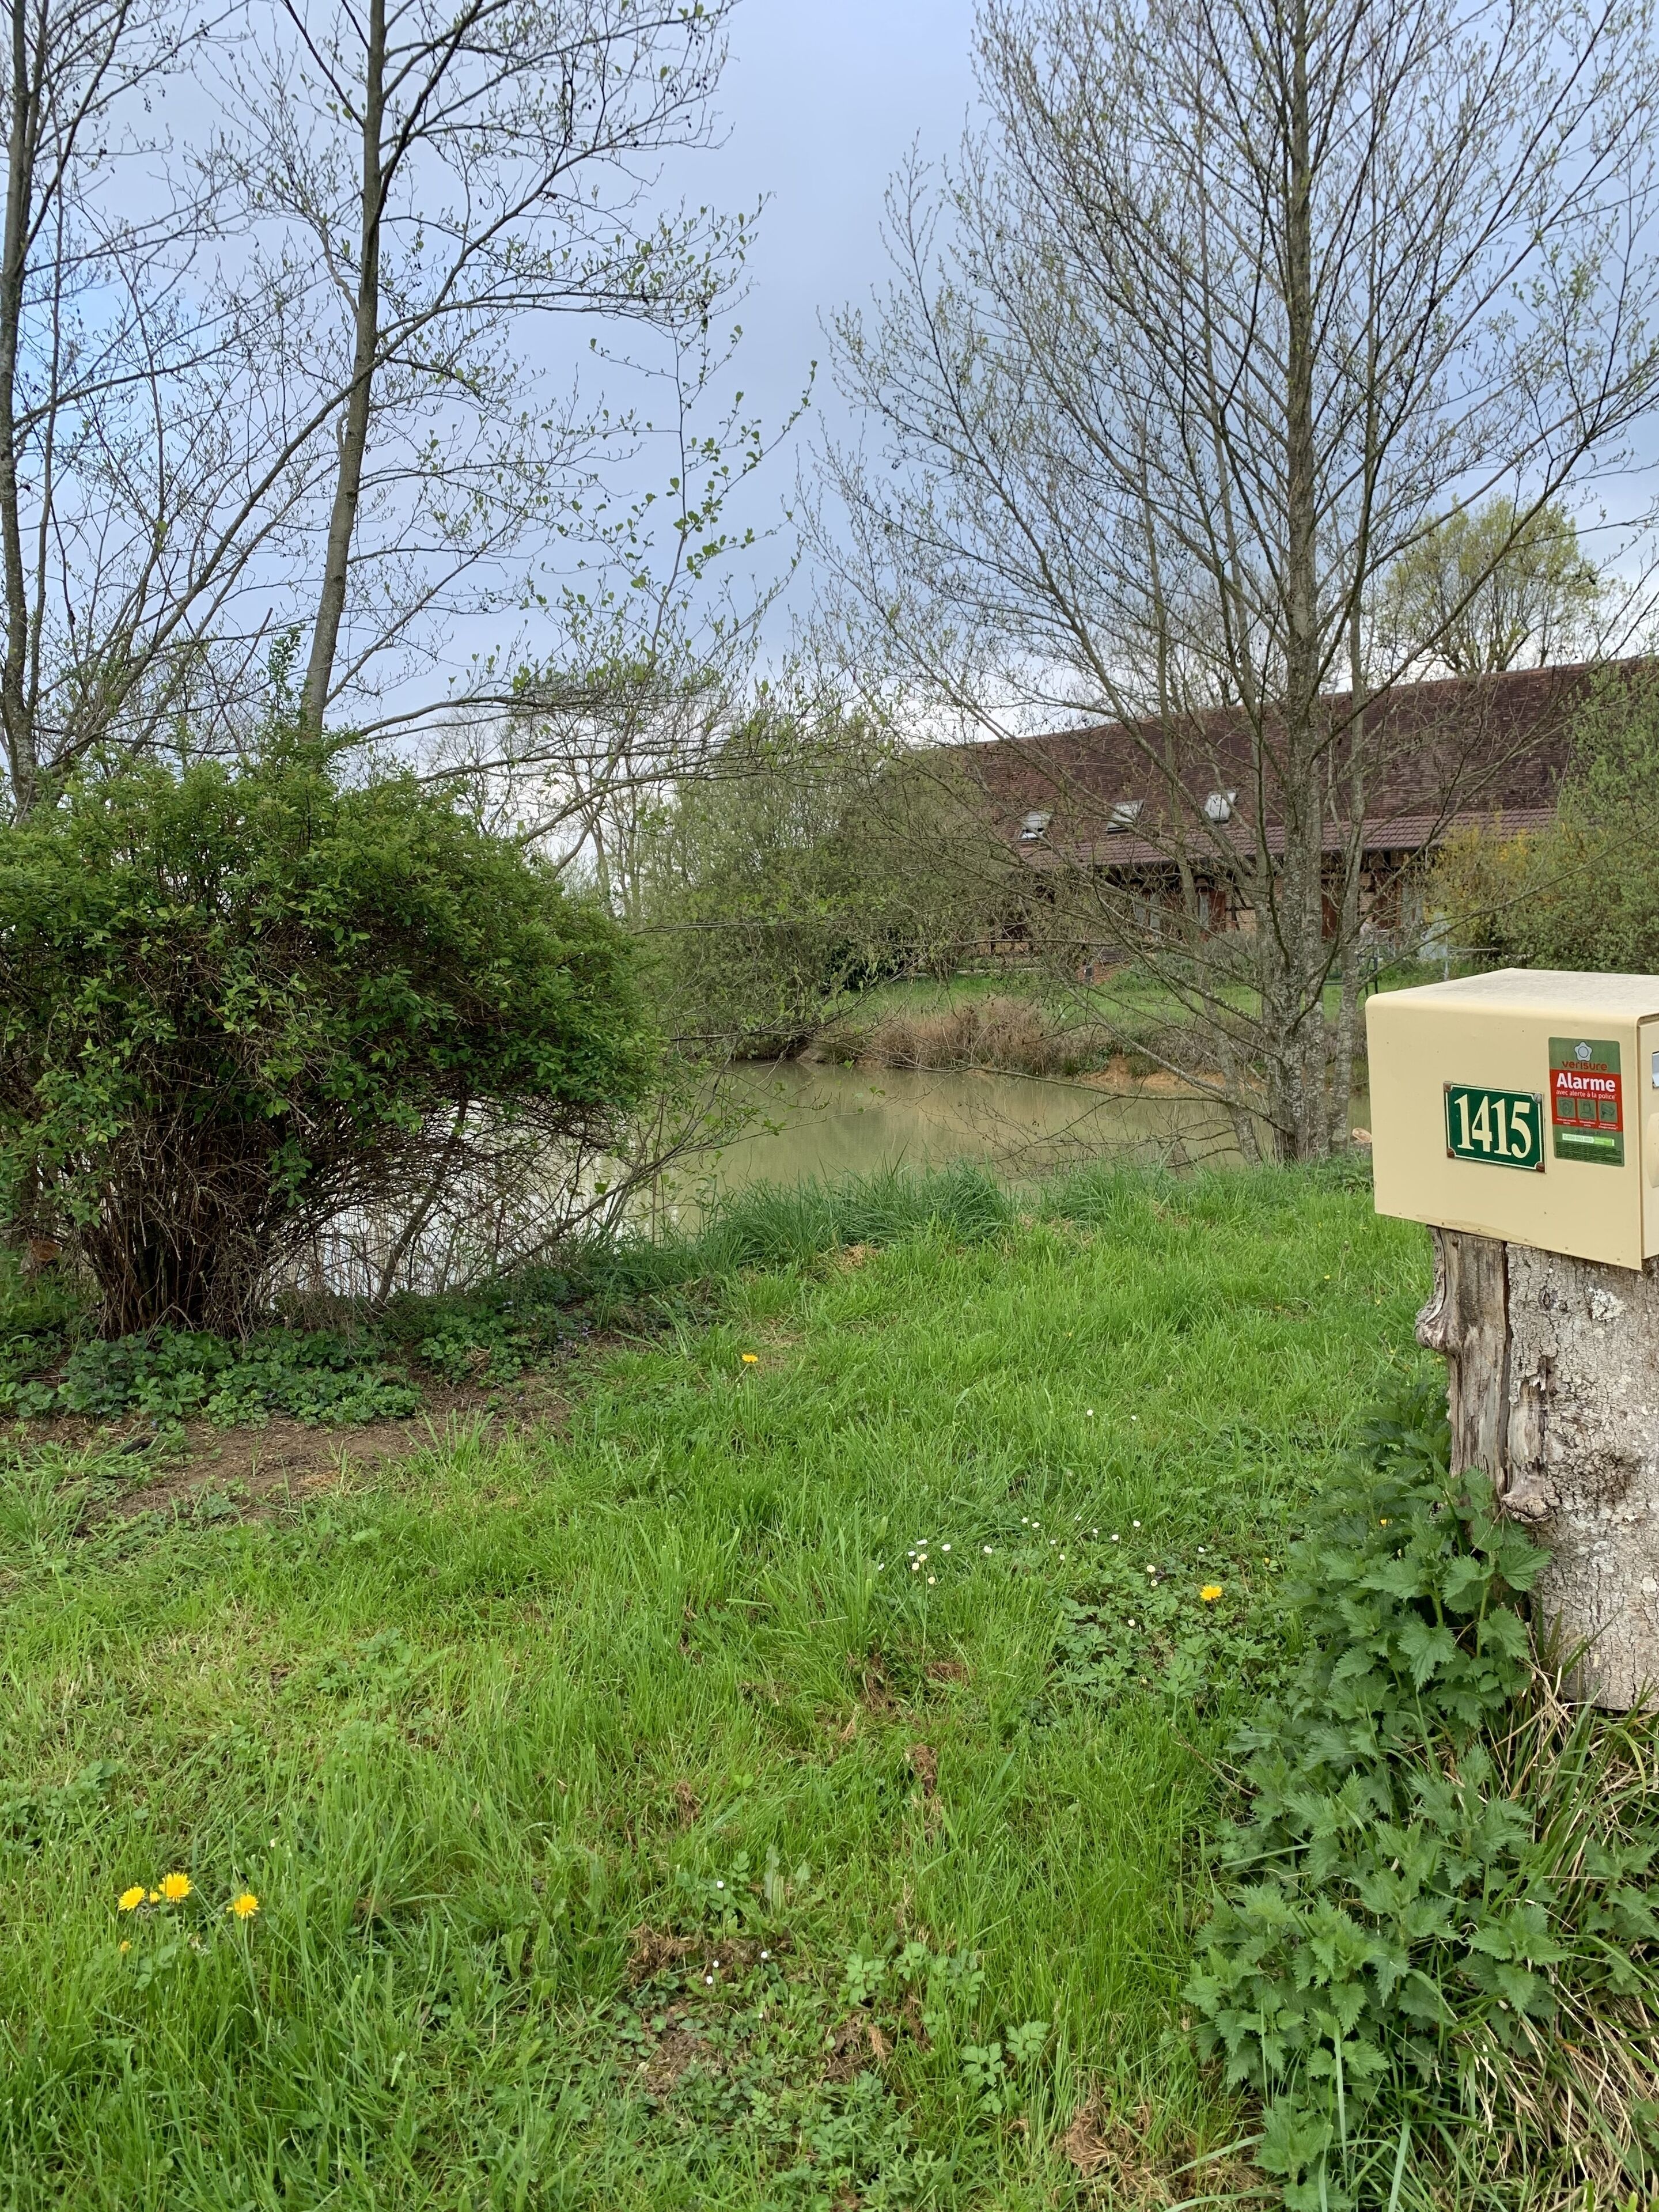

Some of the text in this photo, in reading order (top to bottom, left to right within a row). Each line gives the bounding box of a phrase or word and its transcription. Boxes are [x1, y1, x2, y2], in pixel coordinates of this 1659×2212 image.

[1562, 1061, 1607, 1070] verisure
[1556, 1073, 1616, 1092] Alarme
[1454, 1093, 1532, 1159] 1415
